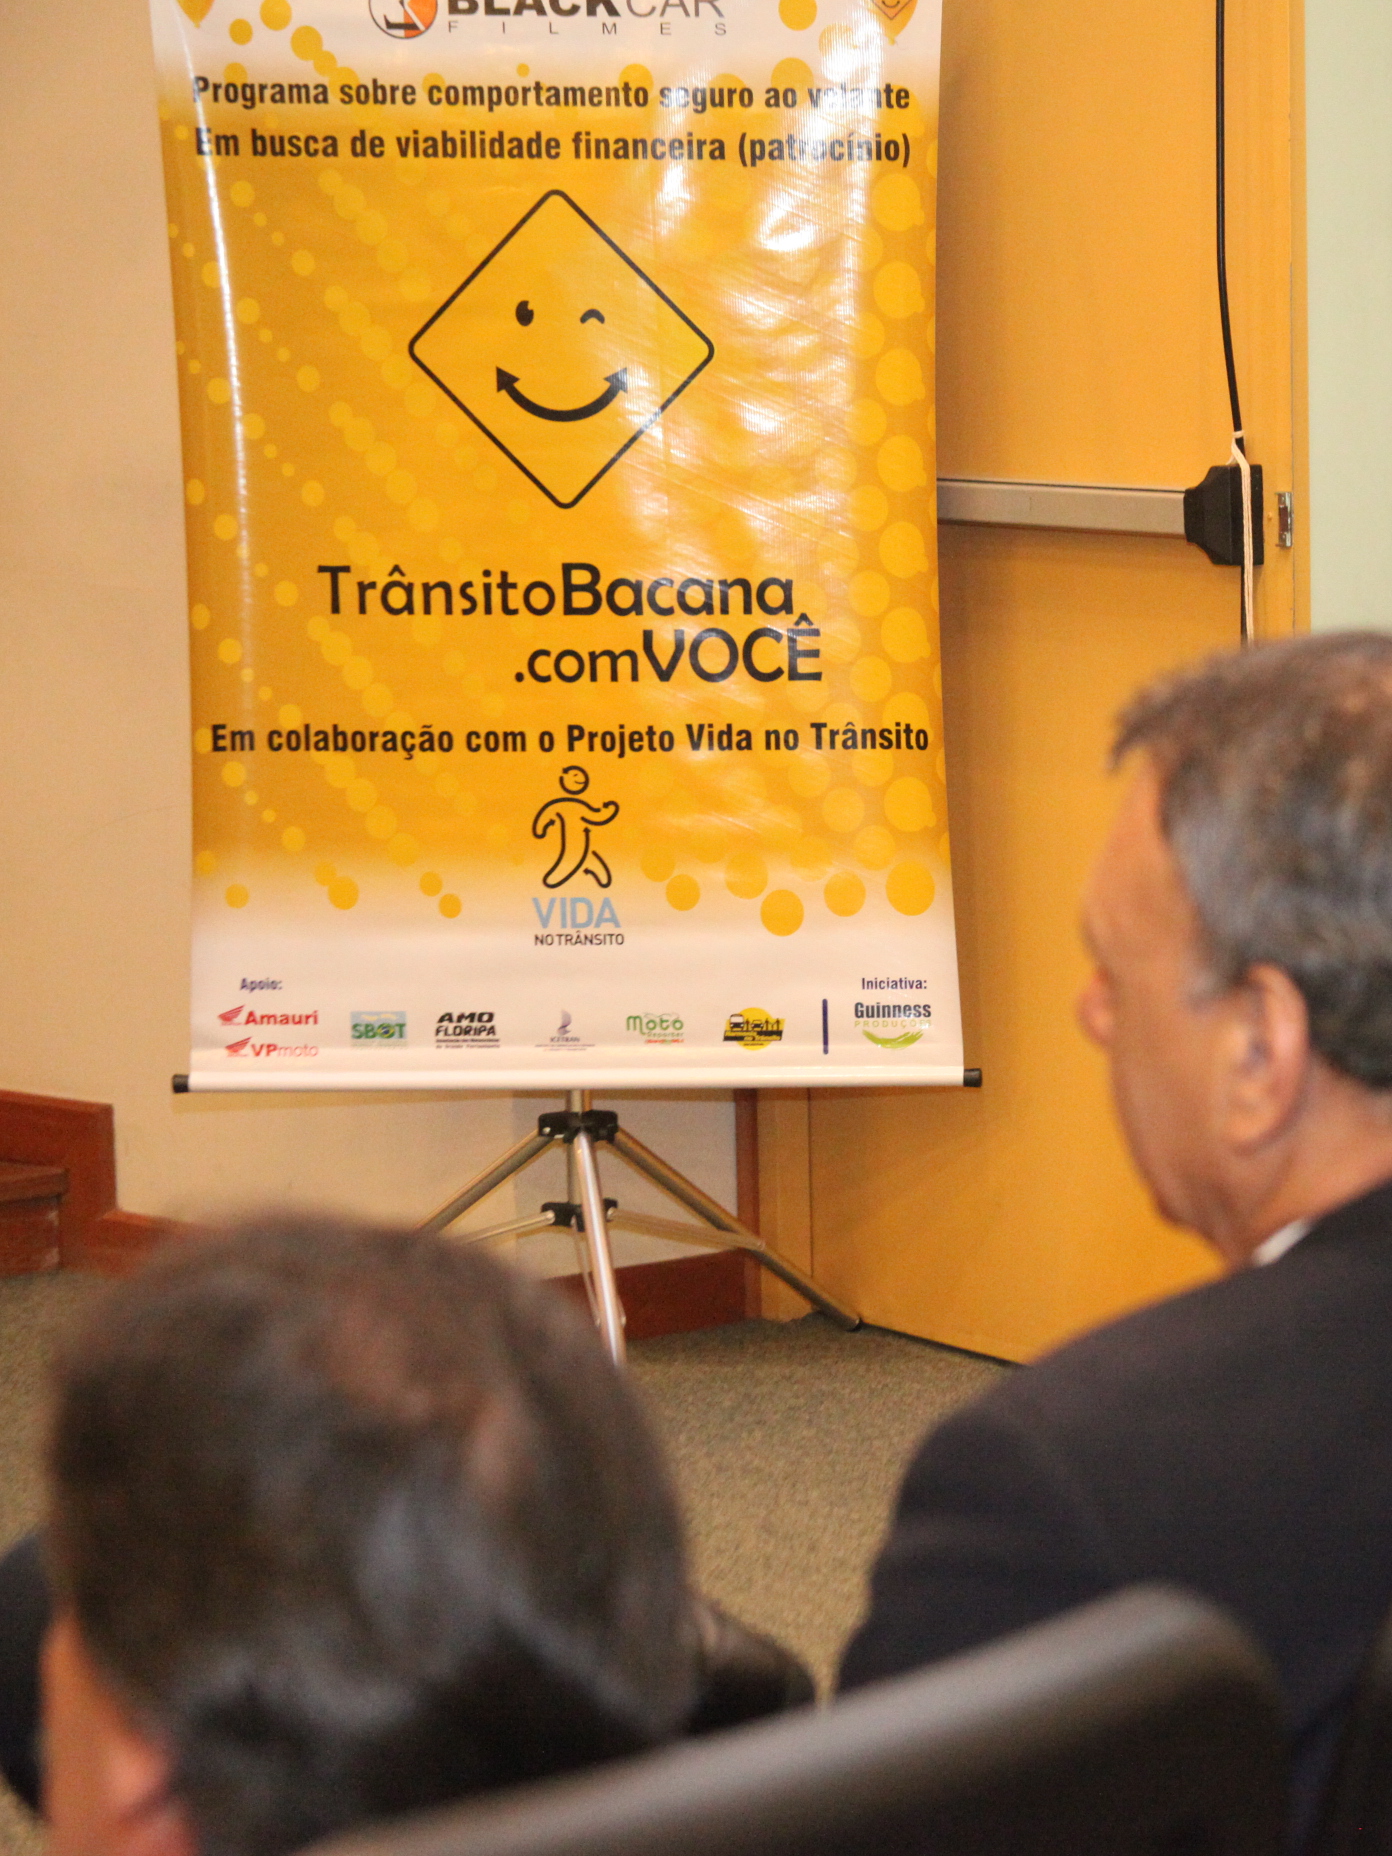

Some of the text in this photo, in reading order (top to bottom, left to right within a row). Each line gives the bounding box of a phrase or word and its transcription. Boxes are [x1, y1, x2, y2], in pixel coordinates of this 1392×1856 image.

[448, 21, 727, 36] FILMES
[194, 76, 329, 109] Programa
[340, 79, 416, 105] sobre
[428, 81, 649, 112] comportamento
[659, 85, 754, 114] seguro
[765, 87, 797, 108] ao
[195, 127, 911, 168] Em busca de viabilidade financeira (patrocínio)
[317, 562, 794, 616] TrânsitoBacana
[211, 722, 929, 761] Em colaboração com o Projeto Vida no Trânsito
[532, 897, 622, 929] VIDA
[240, 977, 283, 993] Apoio:
[861, 977, 928, 990] Iniciativa:
[244, 1010, 319, 1026] Amauri
[437, 1011, 495, 1024] AMO
[854, 1002, 932, 1018] Guinness
[435, 1025, 497, 1037] FLORIPA
